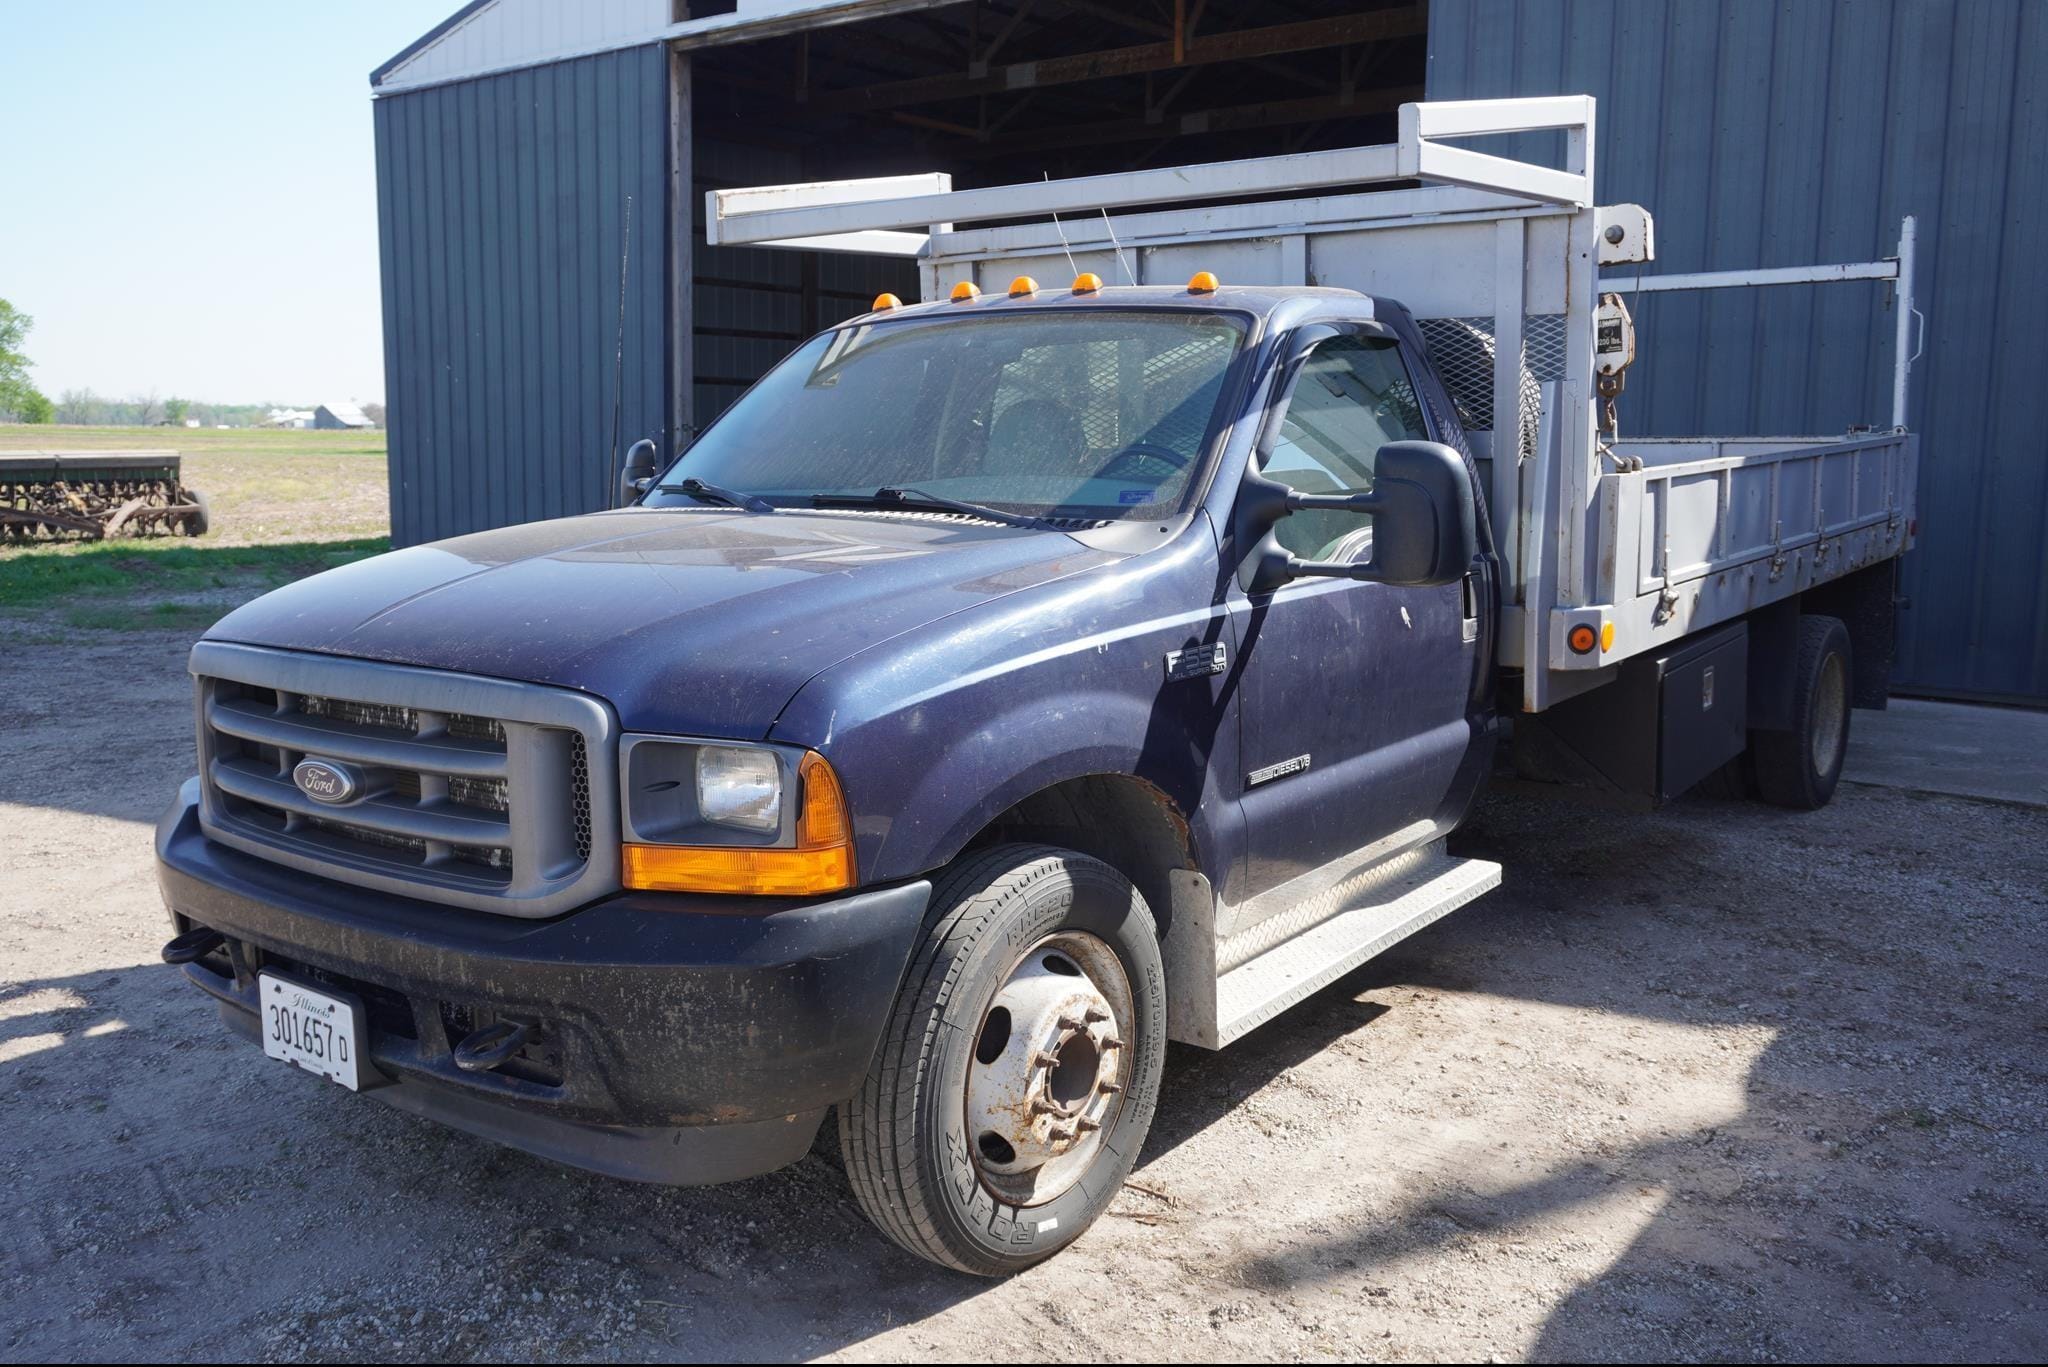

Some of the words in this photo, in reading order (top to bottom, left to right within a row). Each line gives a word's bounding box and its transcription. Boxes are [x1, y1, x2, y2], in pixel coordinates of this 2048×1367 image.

[305, 768, 335, 793] Ford
[288, 993, 331, 1019] Illinois
[270, 1004, 333, 1063] 301657
[339, 1034, 348, 1062] D
[945, 1126, 1037, 1245] ROADX
